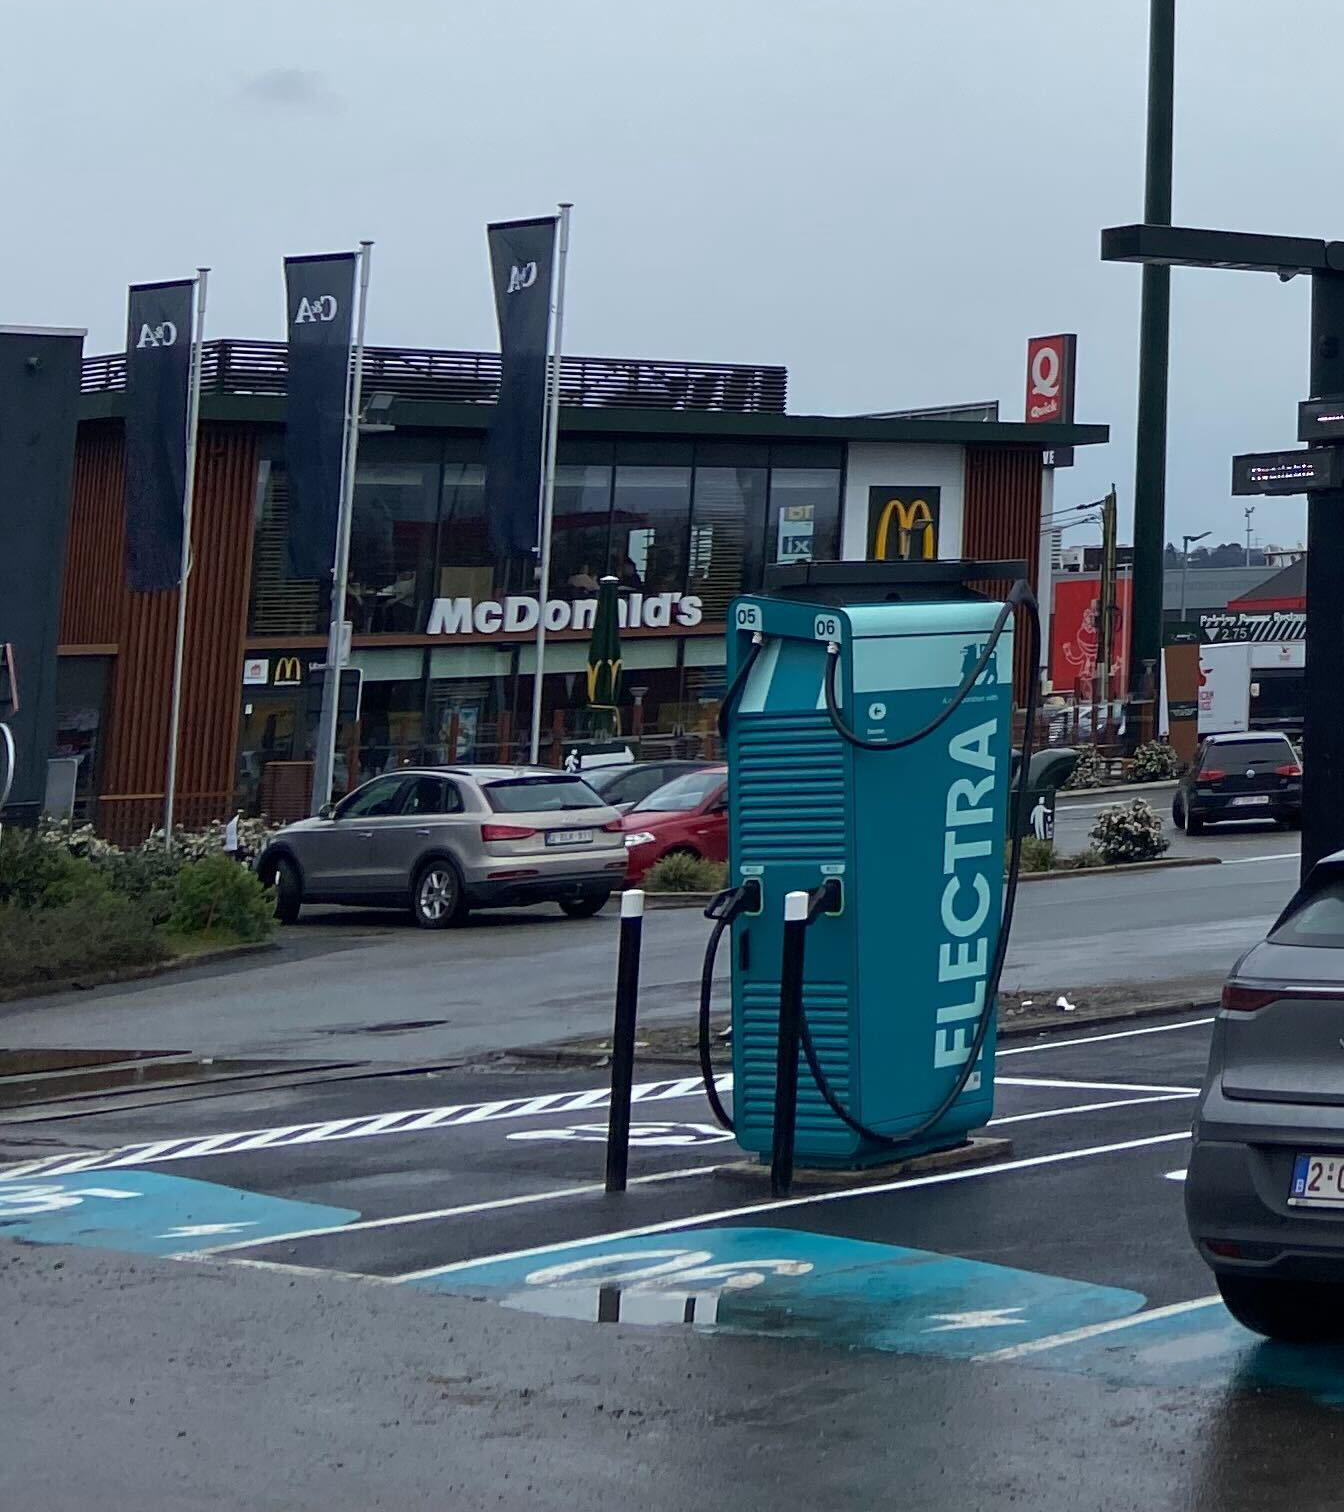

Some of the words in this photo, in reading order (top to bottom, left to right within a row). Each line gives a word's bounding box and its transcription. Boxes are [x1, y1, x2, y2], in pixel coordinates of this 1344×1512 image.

[427, 592, 703, 635] McDonld's
[738, 609, 756, 624] 05
[816, 620, 835, 636] 06
[934, 718, 998, 1069] ELECTRA
